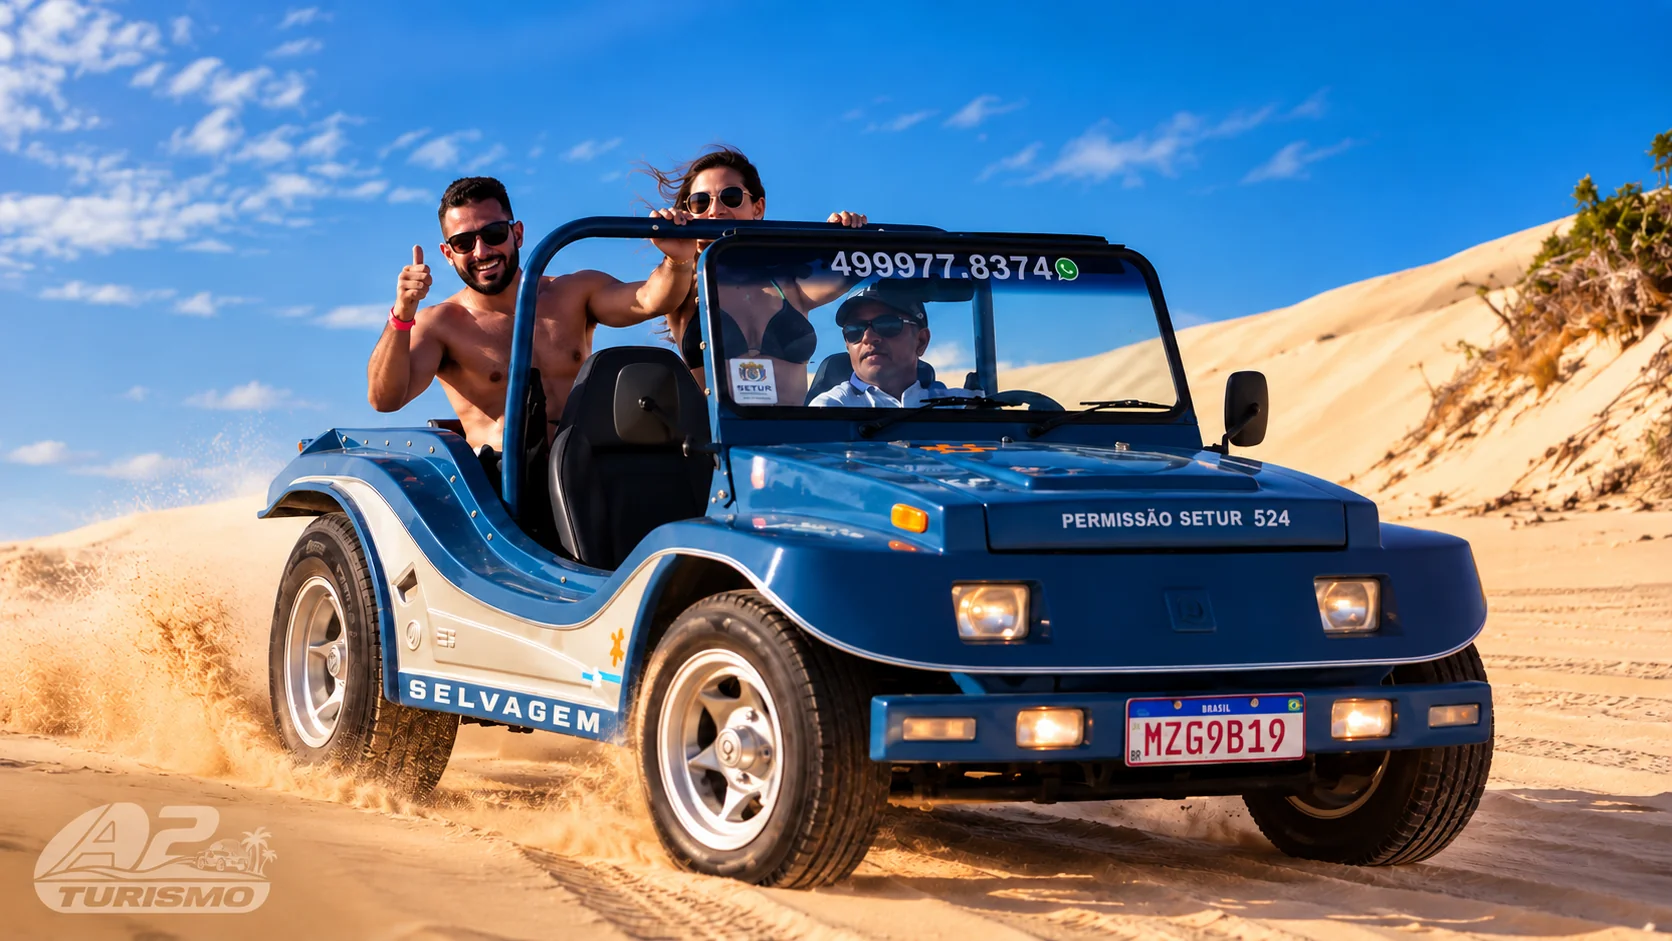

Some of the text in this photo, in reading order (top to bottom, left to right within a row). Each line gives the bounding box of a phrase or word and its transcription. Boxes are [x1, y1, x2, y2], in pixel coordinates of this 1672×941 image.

[831, 251, 1052, 280] 499977.8374
[737, 384, 772, 392] SETUR
[1062, 508, 1290, 528] PERMISSÃO SETUR 524
[409, 679, 600, 733] SELVAGEM
[1202, 704, 1230, 713] BRASIL
[1144, 718, 1286, 756] MZG9B19
[1131, 750, 1141, 761] BR
